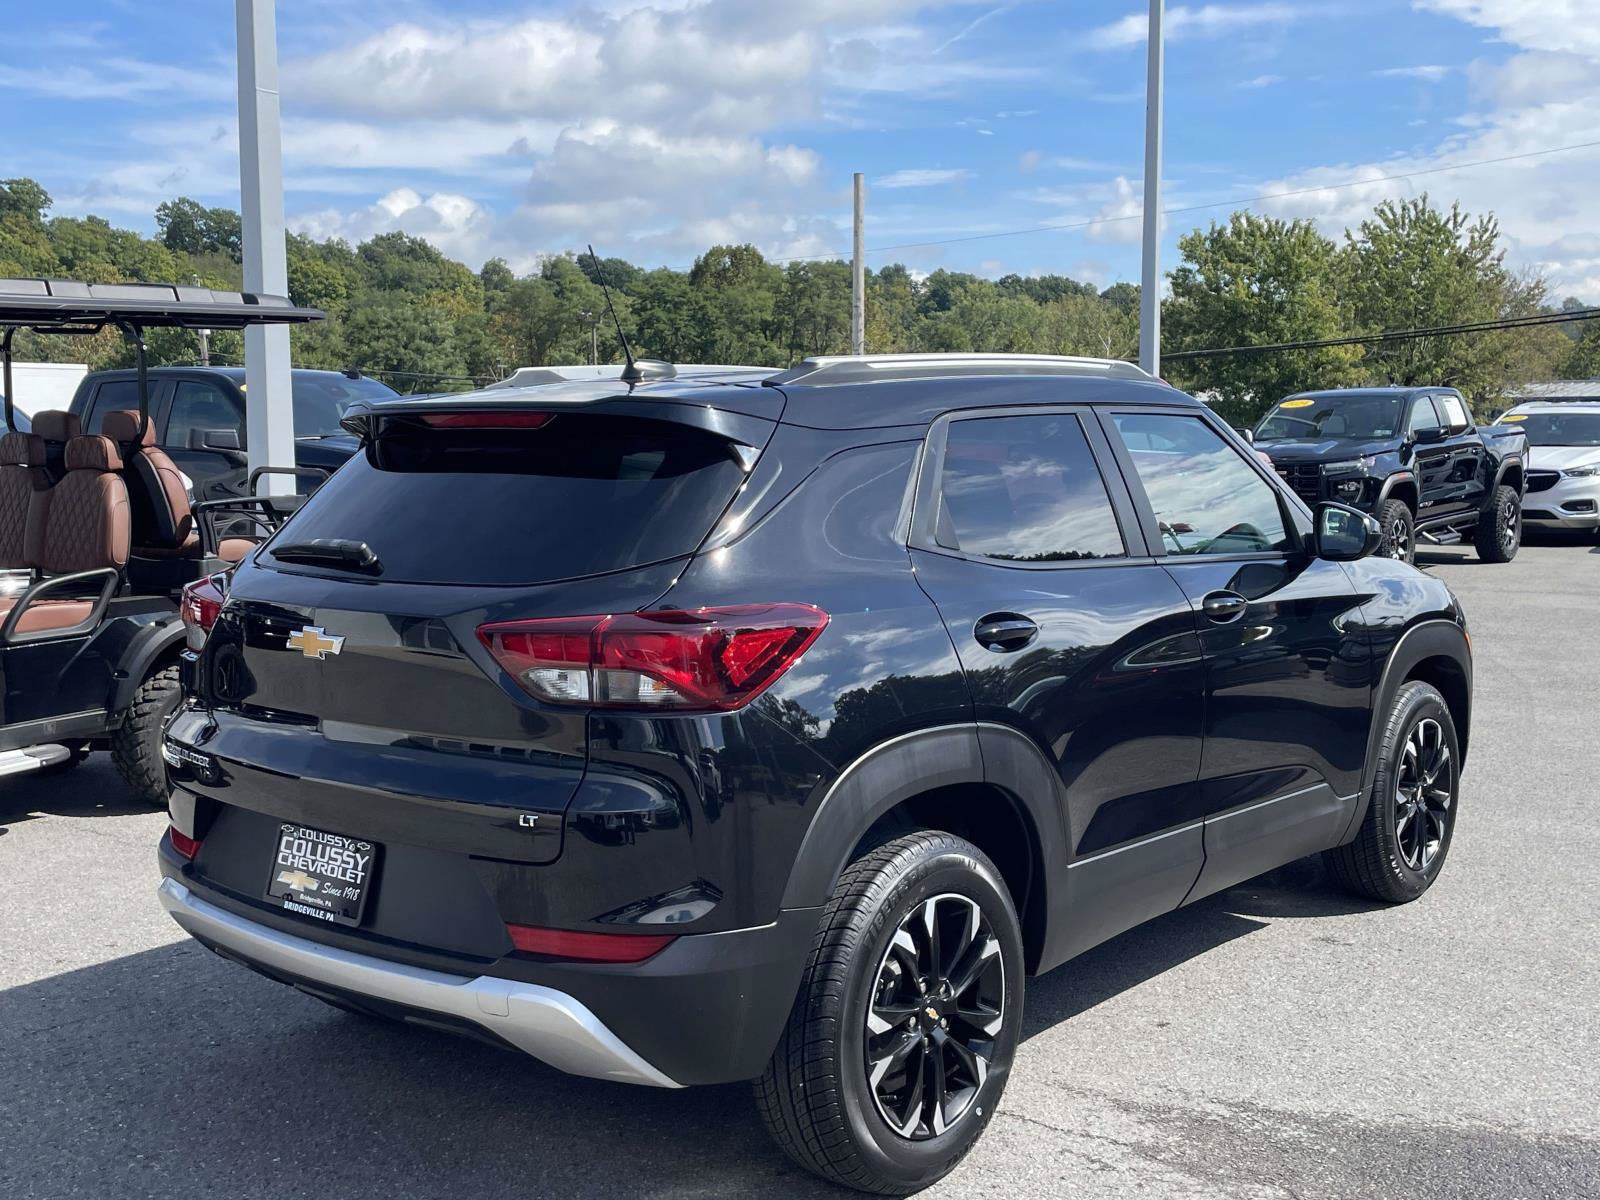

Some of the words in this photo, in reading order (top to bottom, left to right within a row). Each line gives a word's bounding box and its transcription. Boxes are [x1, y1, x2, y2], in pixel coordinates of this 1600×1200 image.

[519, 814, 539, 827] LT
[299, 828, 351, 849] COLUSSY
[280, 836, 370, 872] COLUSSY
[277, 852, 365, 885] CHEVROLET
[321, 882, 342, 897] Since
[342, 886, 361, 901] 1918
[325, 912, 335, 922] PA
